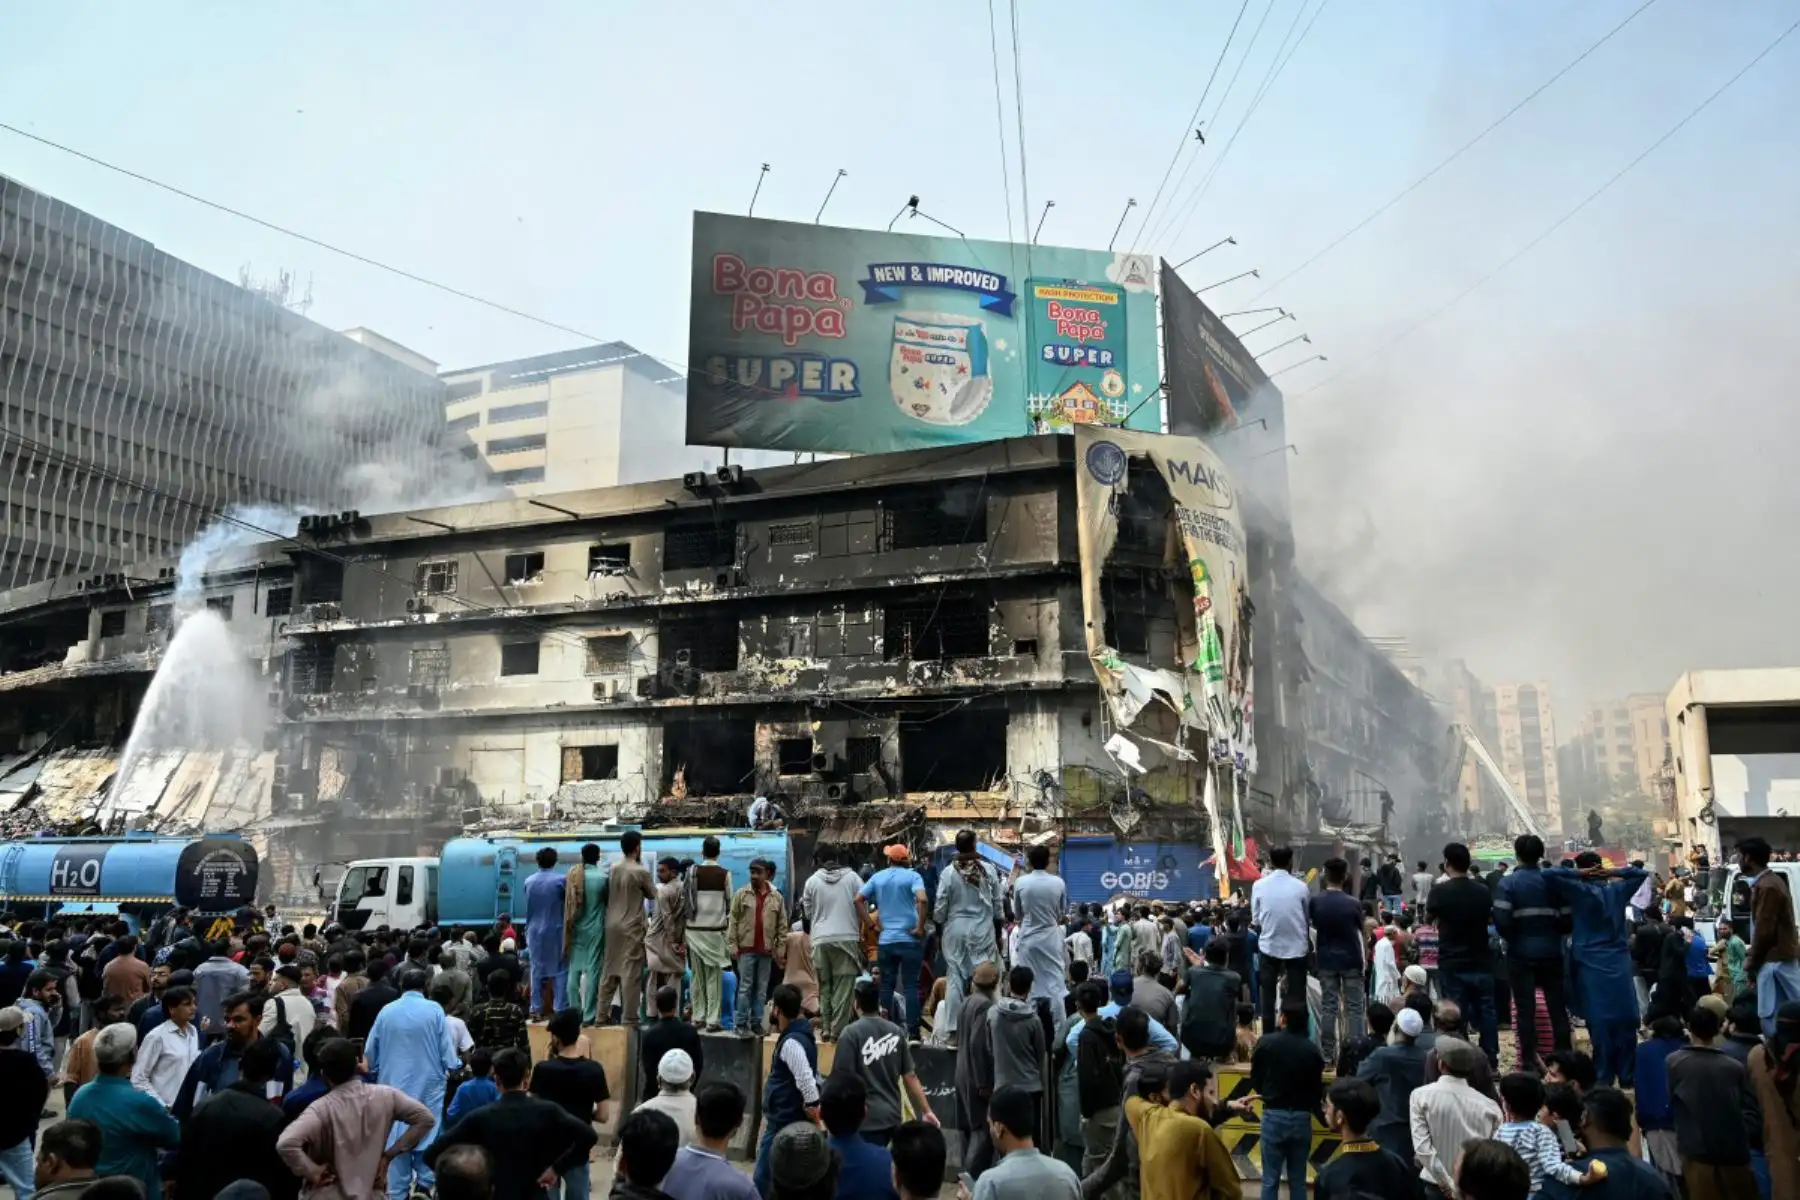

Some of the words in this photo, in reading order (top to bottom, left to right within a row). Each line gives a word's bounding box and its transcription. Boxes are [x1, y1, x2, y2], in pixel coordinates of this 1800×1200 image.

[713, 253, 837, 301] Bona
[874, 266, 906, 283] NEW
[911, 266, 924, 282] &
[927, 267, 1000, 292] IMPROVED
[733, 291, 846, 346] Papa
[1048, 301, 1102, 323] Bona
[1057, 318, 1105, 343] Papa
[1043, 344, 1113, 366] SUPER
[705, 355, 857, 393] SUPER
[51, 859, 100, 887] H2O
